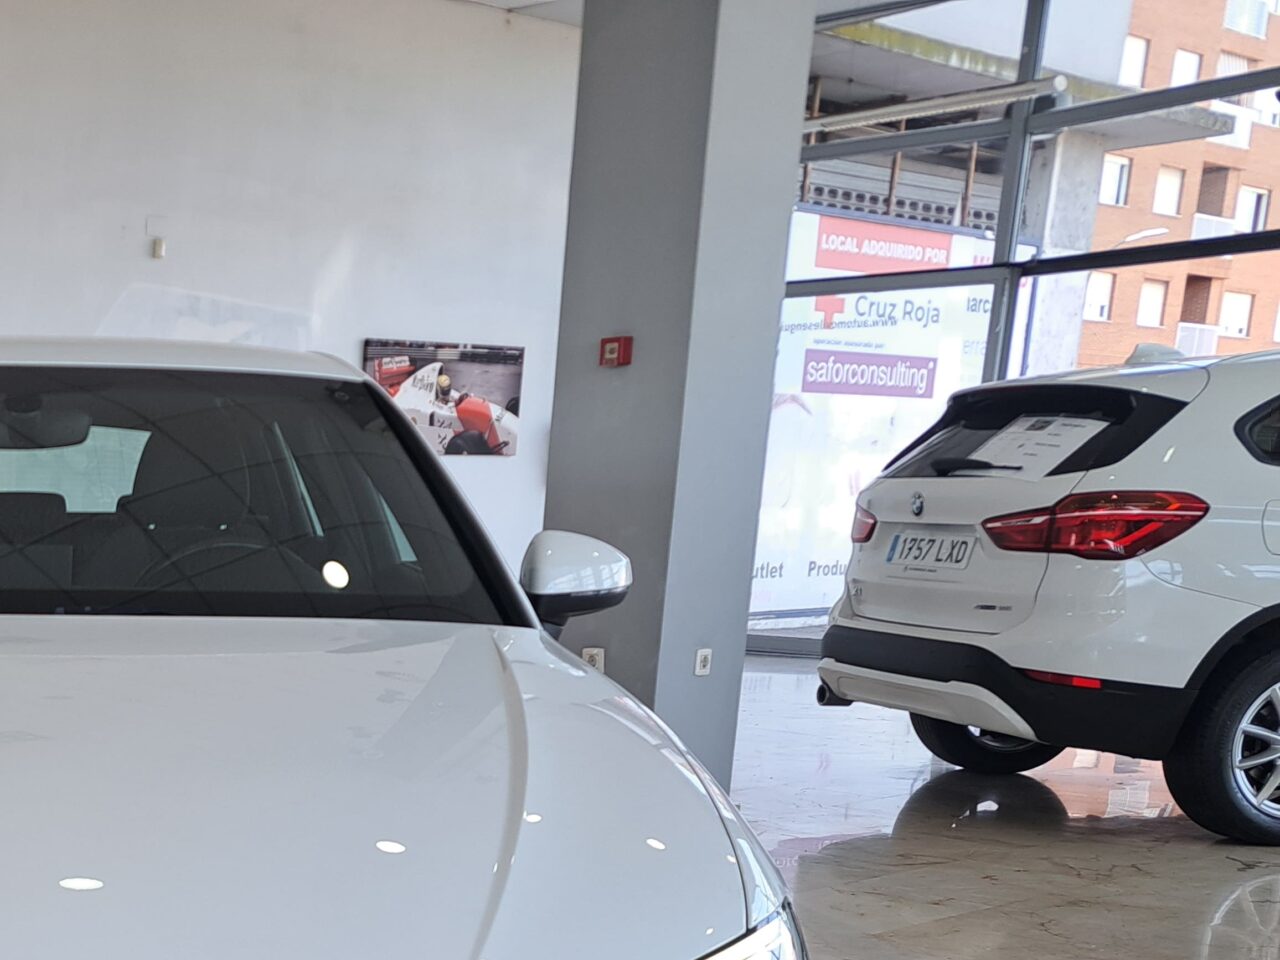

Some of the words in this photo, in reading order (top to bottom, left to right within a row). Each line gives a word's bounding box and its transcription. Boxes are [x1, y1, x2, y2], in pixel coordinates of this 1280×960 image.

[821, 233, 860, 254] LOCAL
[861, 239, 923, 262] ADQUIRIDO
[924, 246, 948, 264] POR
[855, 295, 897, 320] Cruz
[902, 300, 941, 329] Roja
[806, 355, 929, 394] saforconsulting
[898, 537, 936, 561] 1757
[935, 539, 969, 564] LXD
